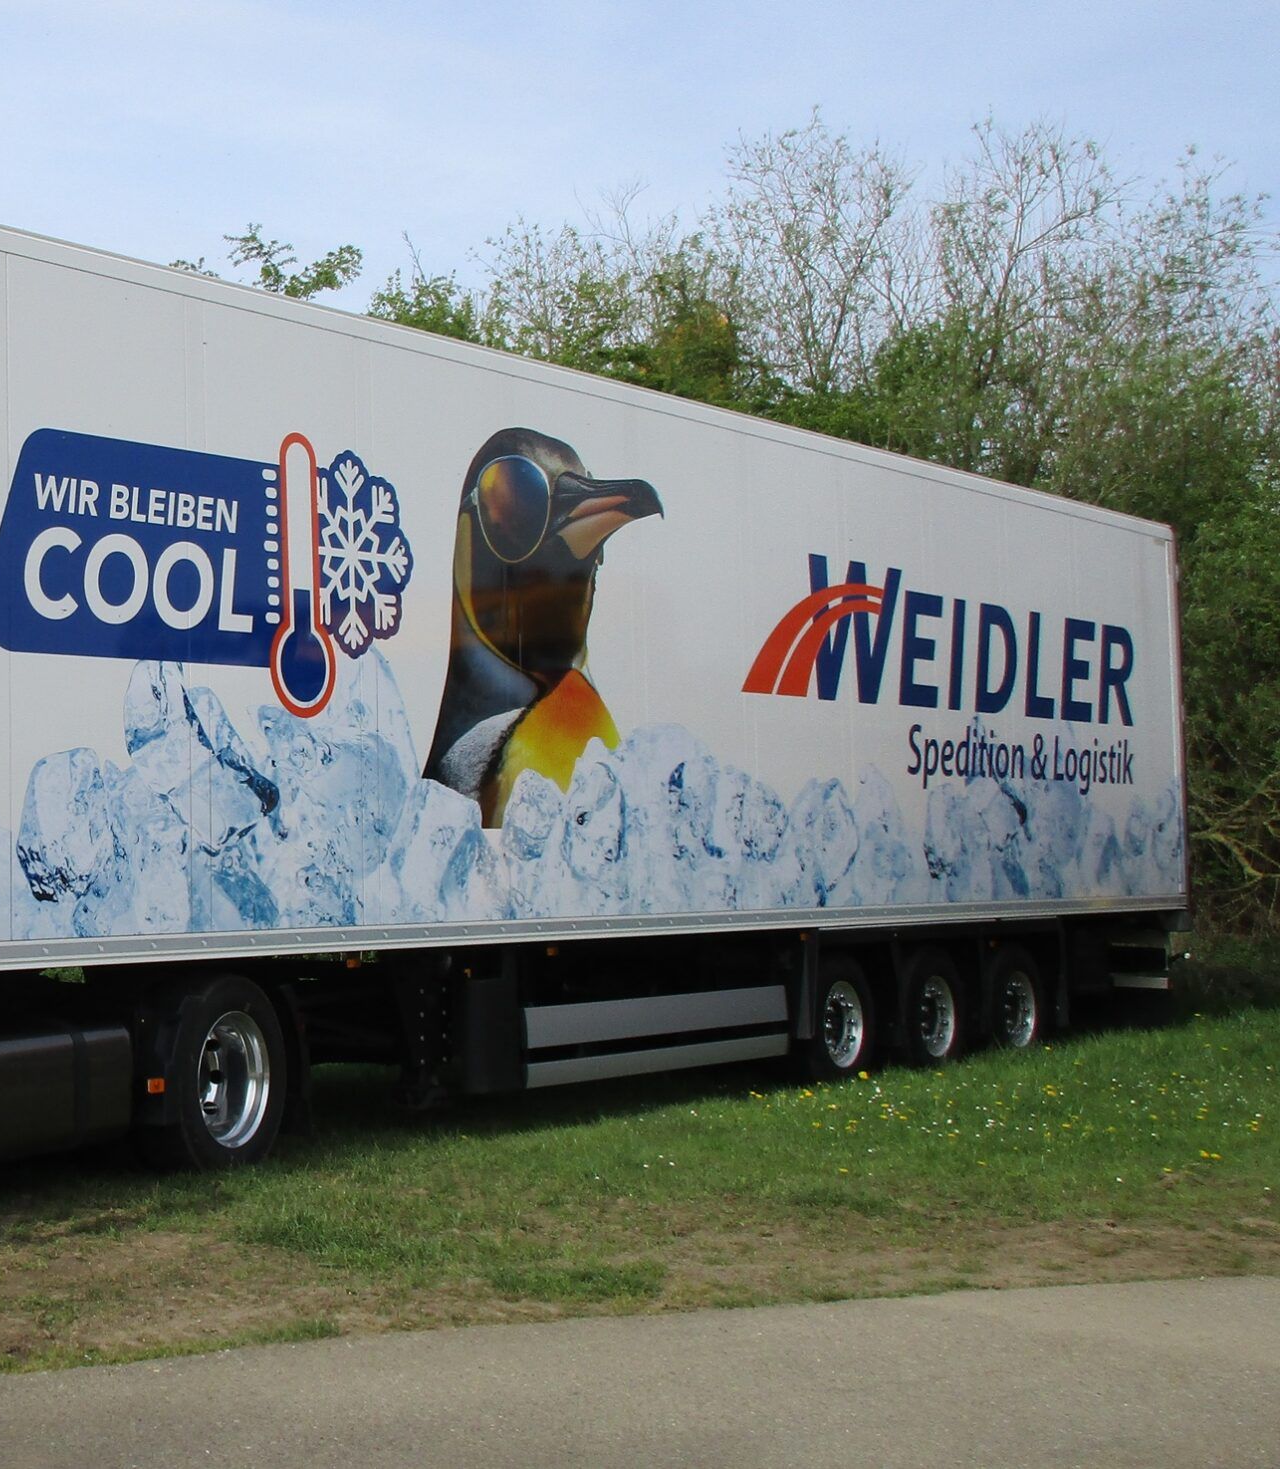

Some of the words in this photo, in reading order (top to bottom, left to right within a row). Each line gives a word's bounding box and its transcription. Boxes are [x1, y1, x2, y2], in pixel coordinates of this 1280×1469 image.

[34, 473, 99, 516] WIR
[109, 483, 239, 534] BLEIBEN
[23, 526, 255, 634] COOL
[808, 553, 1136, 728] WEIDLER
[907, 724, 1025, 790] Spedition
[1030, 732, 1049, 782] &
[1053, 735, 1135, 796] Logistik
